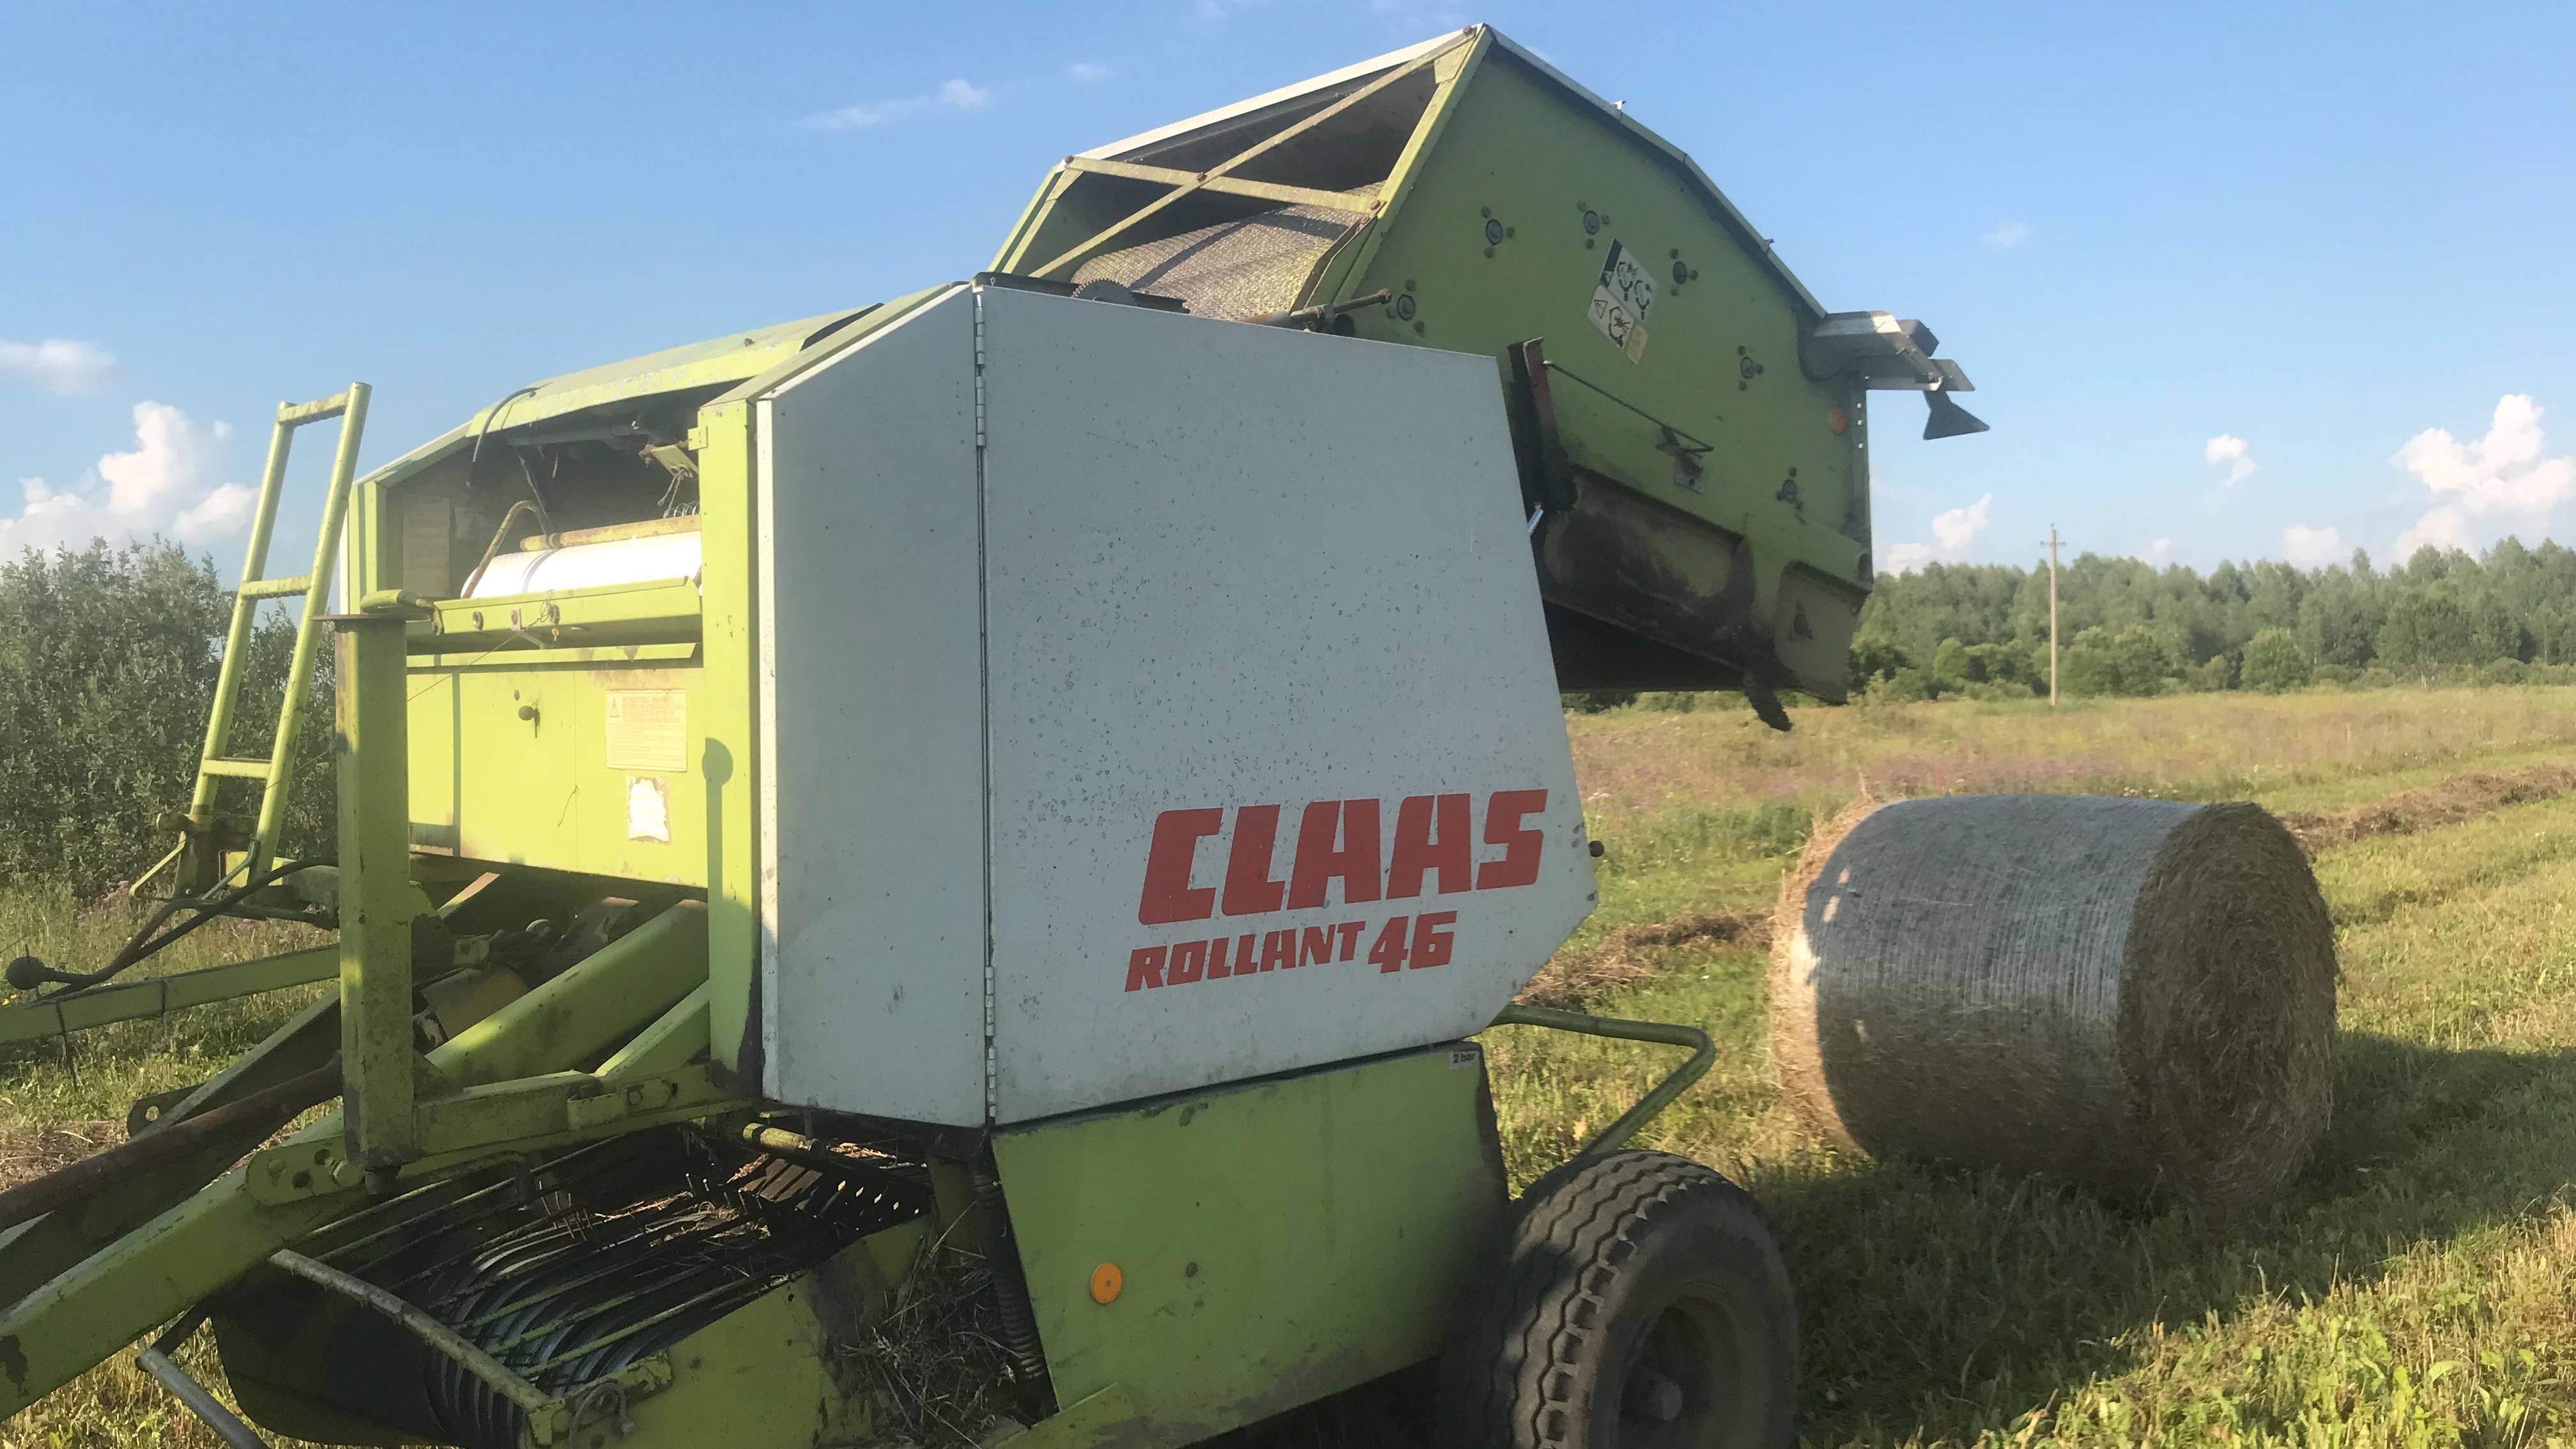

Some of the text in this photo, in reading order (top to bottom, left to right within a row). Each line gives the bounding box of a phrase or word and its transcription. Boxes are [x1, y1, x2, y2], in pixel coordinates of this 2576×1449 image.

[1138, 789, 1548, 925] CLAAS
[1124, 910, 1457, 992] ROLLANT 46
